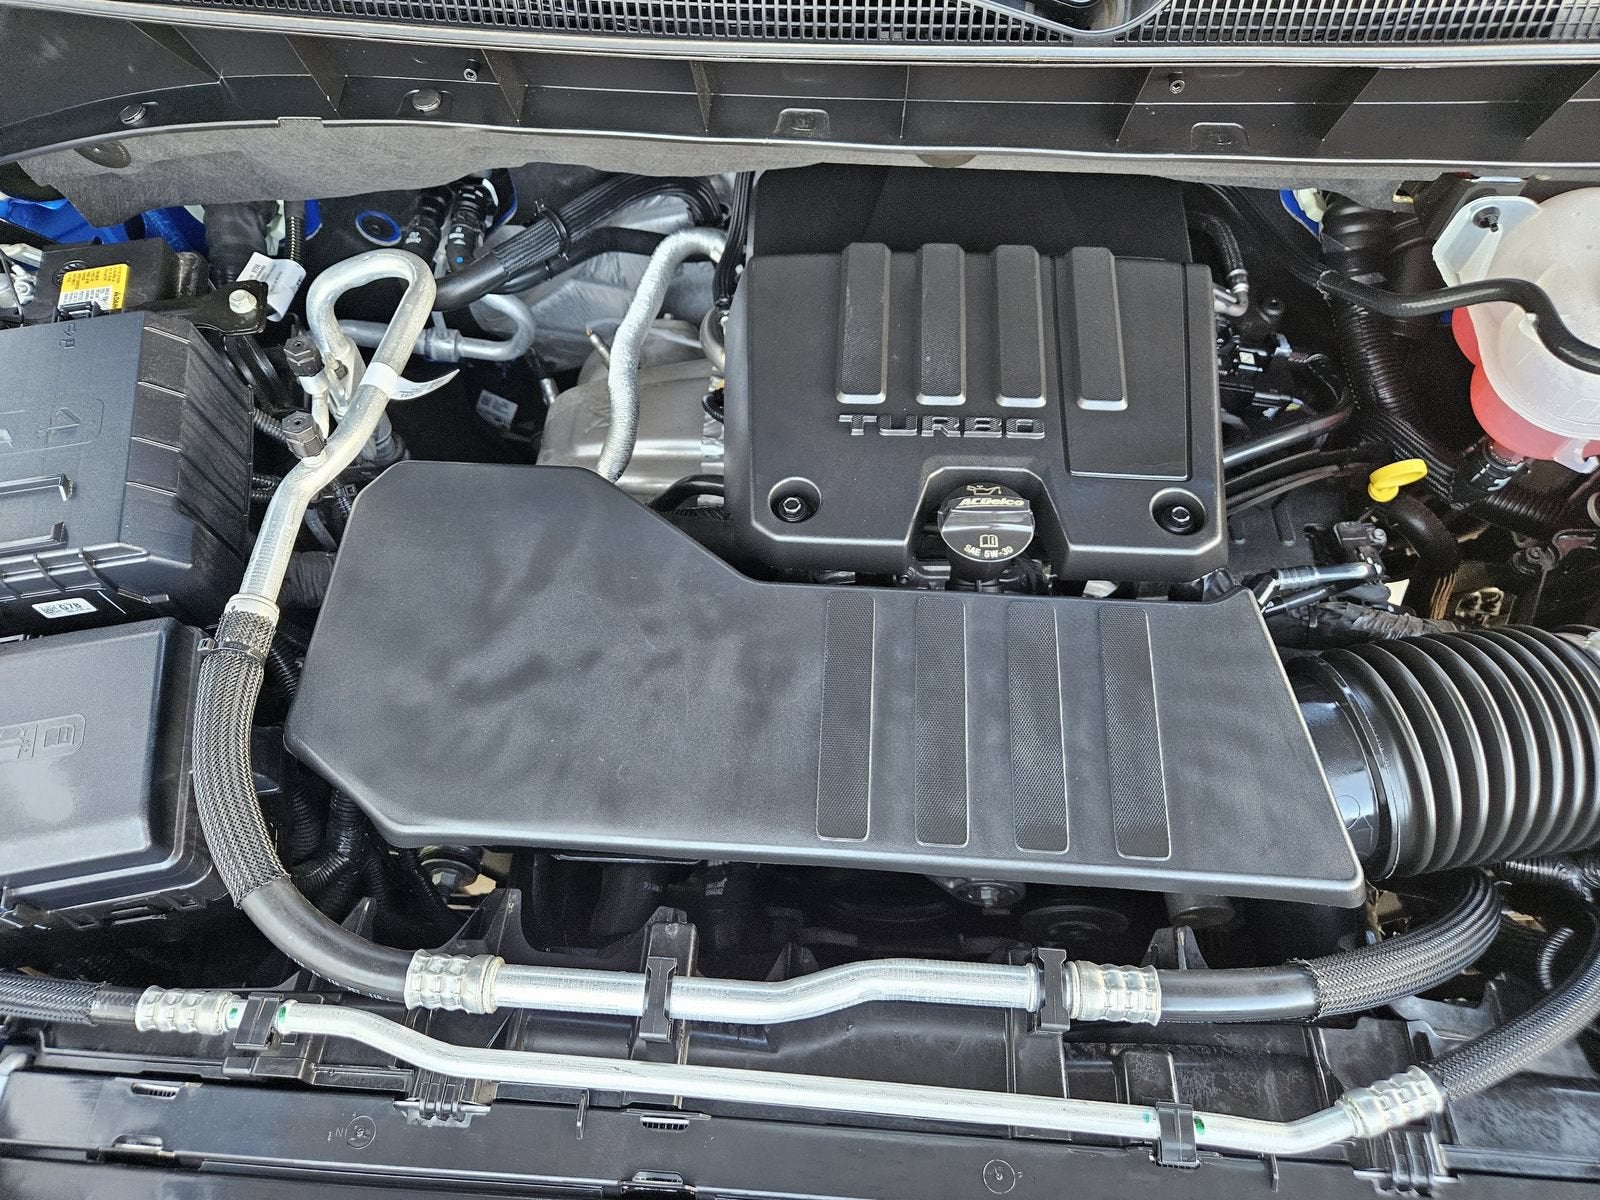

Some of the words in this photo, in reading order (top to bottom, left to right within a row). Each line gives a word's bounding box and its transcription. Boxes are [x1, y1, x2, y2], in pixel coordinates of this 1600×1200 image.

[838, 414, 1045, 439] TURBO
[958, 497, 1025, 508] ACDelco
[964, 544, 982, 556] SAE
[984, 545, 1014, 558] 5W-30
